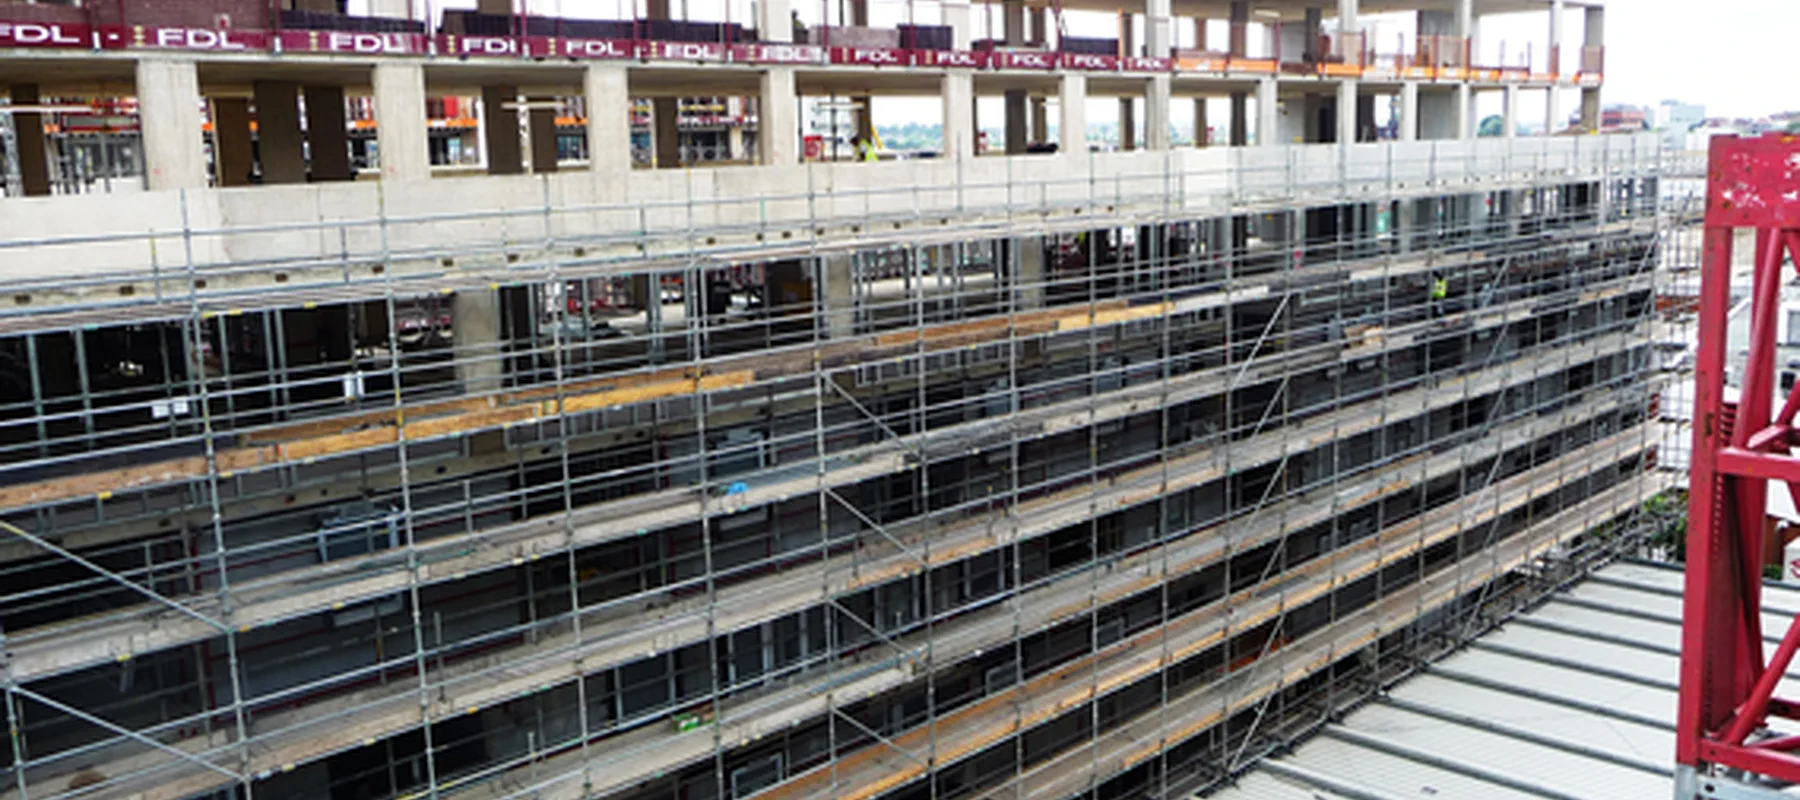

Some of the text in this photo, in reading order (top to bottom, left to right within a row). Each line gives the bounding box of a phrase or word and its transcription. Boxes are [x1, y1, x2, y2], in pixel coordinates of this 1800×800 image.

[157, 28, 244, 49] FDL
[329, 34, 408, 52] FDL
[566, 41, 624, 56] FDL
[664, 44, 722, 59] FDL
[855, 50, 897, 62] FDL
[937, 52, 976, 64] FDL
[1012, 54, 1046, 66] FDL
[1074, 56, 1107, 67] FDL
